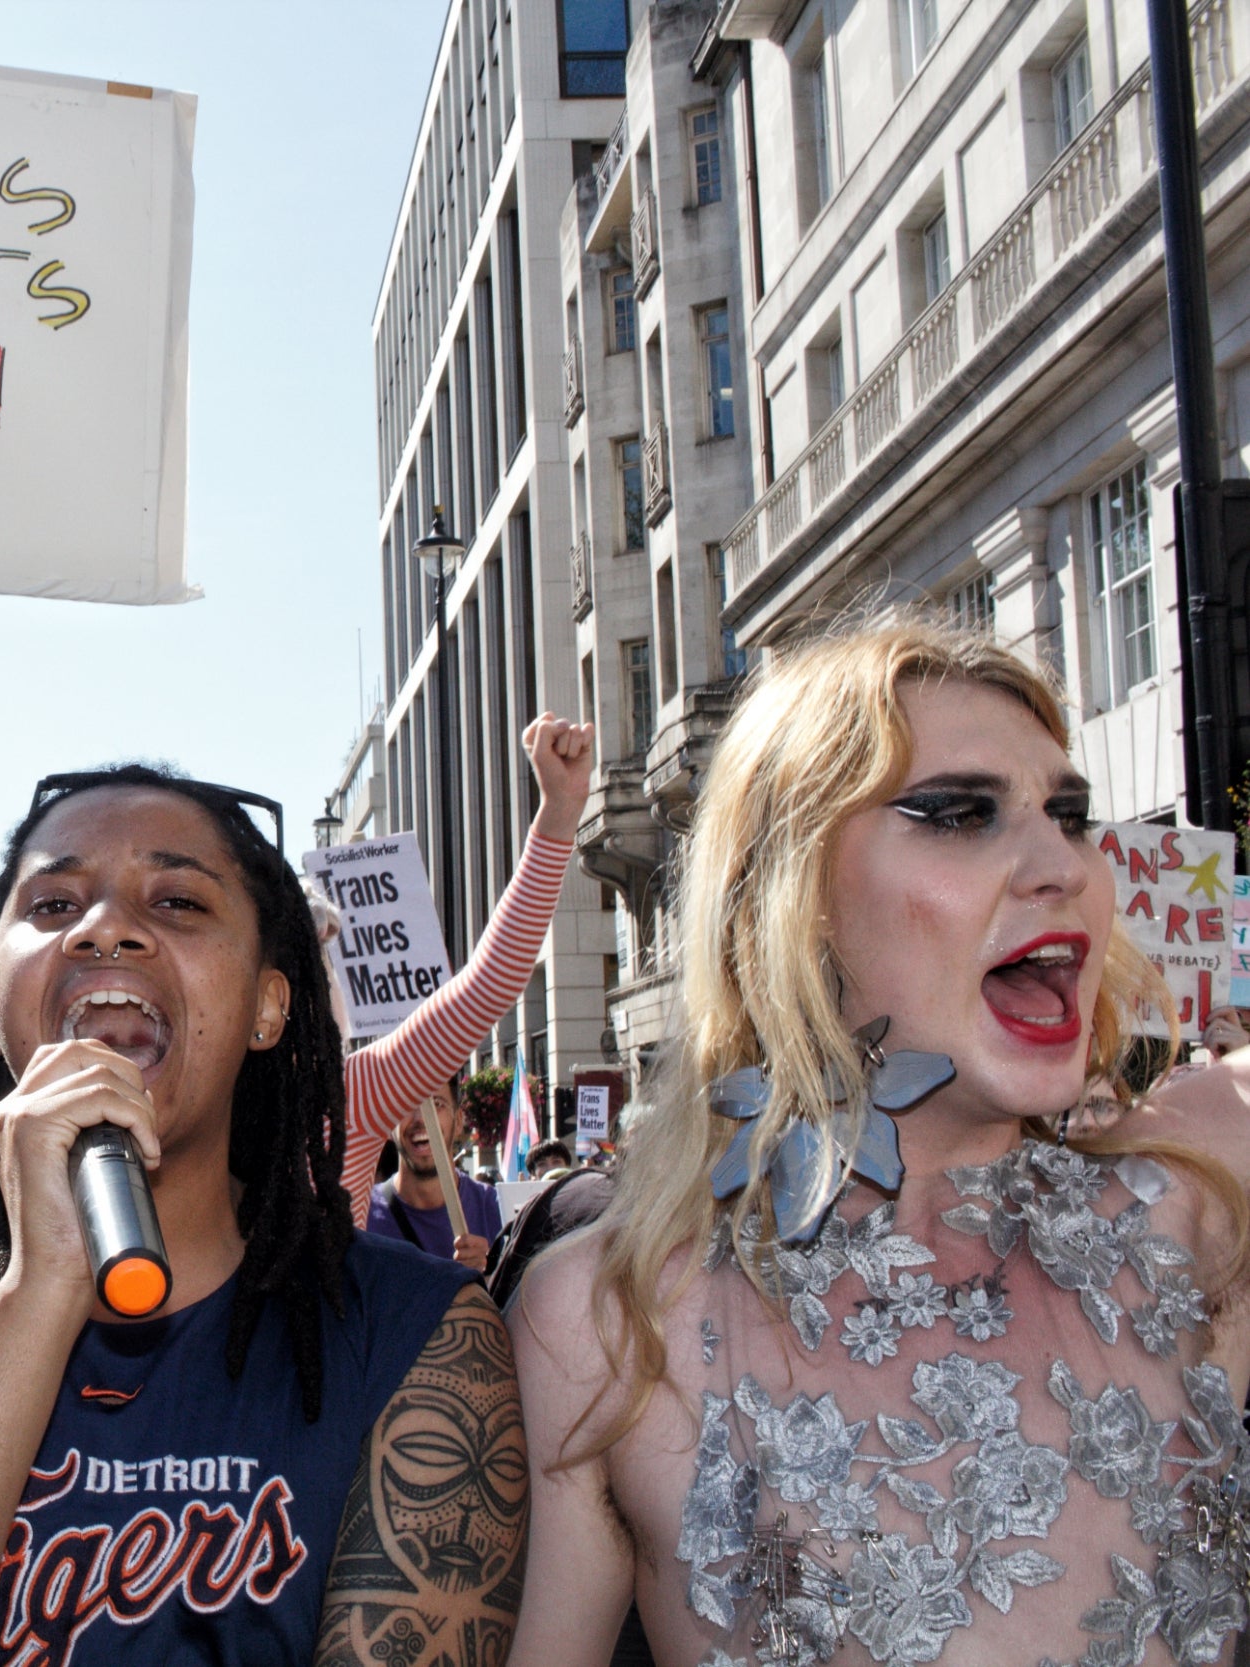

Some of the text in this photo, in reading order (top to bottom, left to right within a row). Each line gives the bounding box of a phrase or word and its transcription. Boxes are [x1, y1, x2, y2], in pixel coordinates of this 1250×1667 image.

[1099, 829, 1184, 884] ANS
[316, 868, 399, 910] Trans
[338, 915, 410, 960] Lives
[1125, 890, 1226, 946] ARE
[345, 959, 443, 1008] Matter
[580, 1092, 600, 1104] Trans
[580, 1105, 599, 1117] Lives
[580, 1118, 605, 1130] Matter
[84, 1454, 259, 1493] DETROIT
